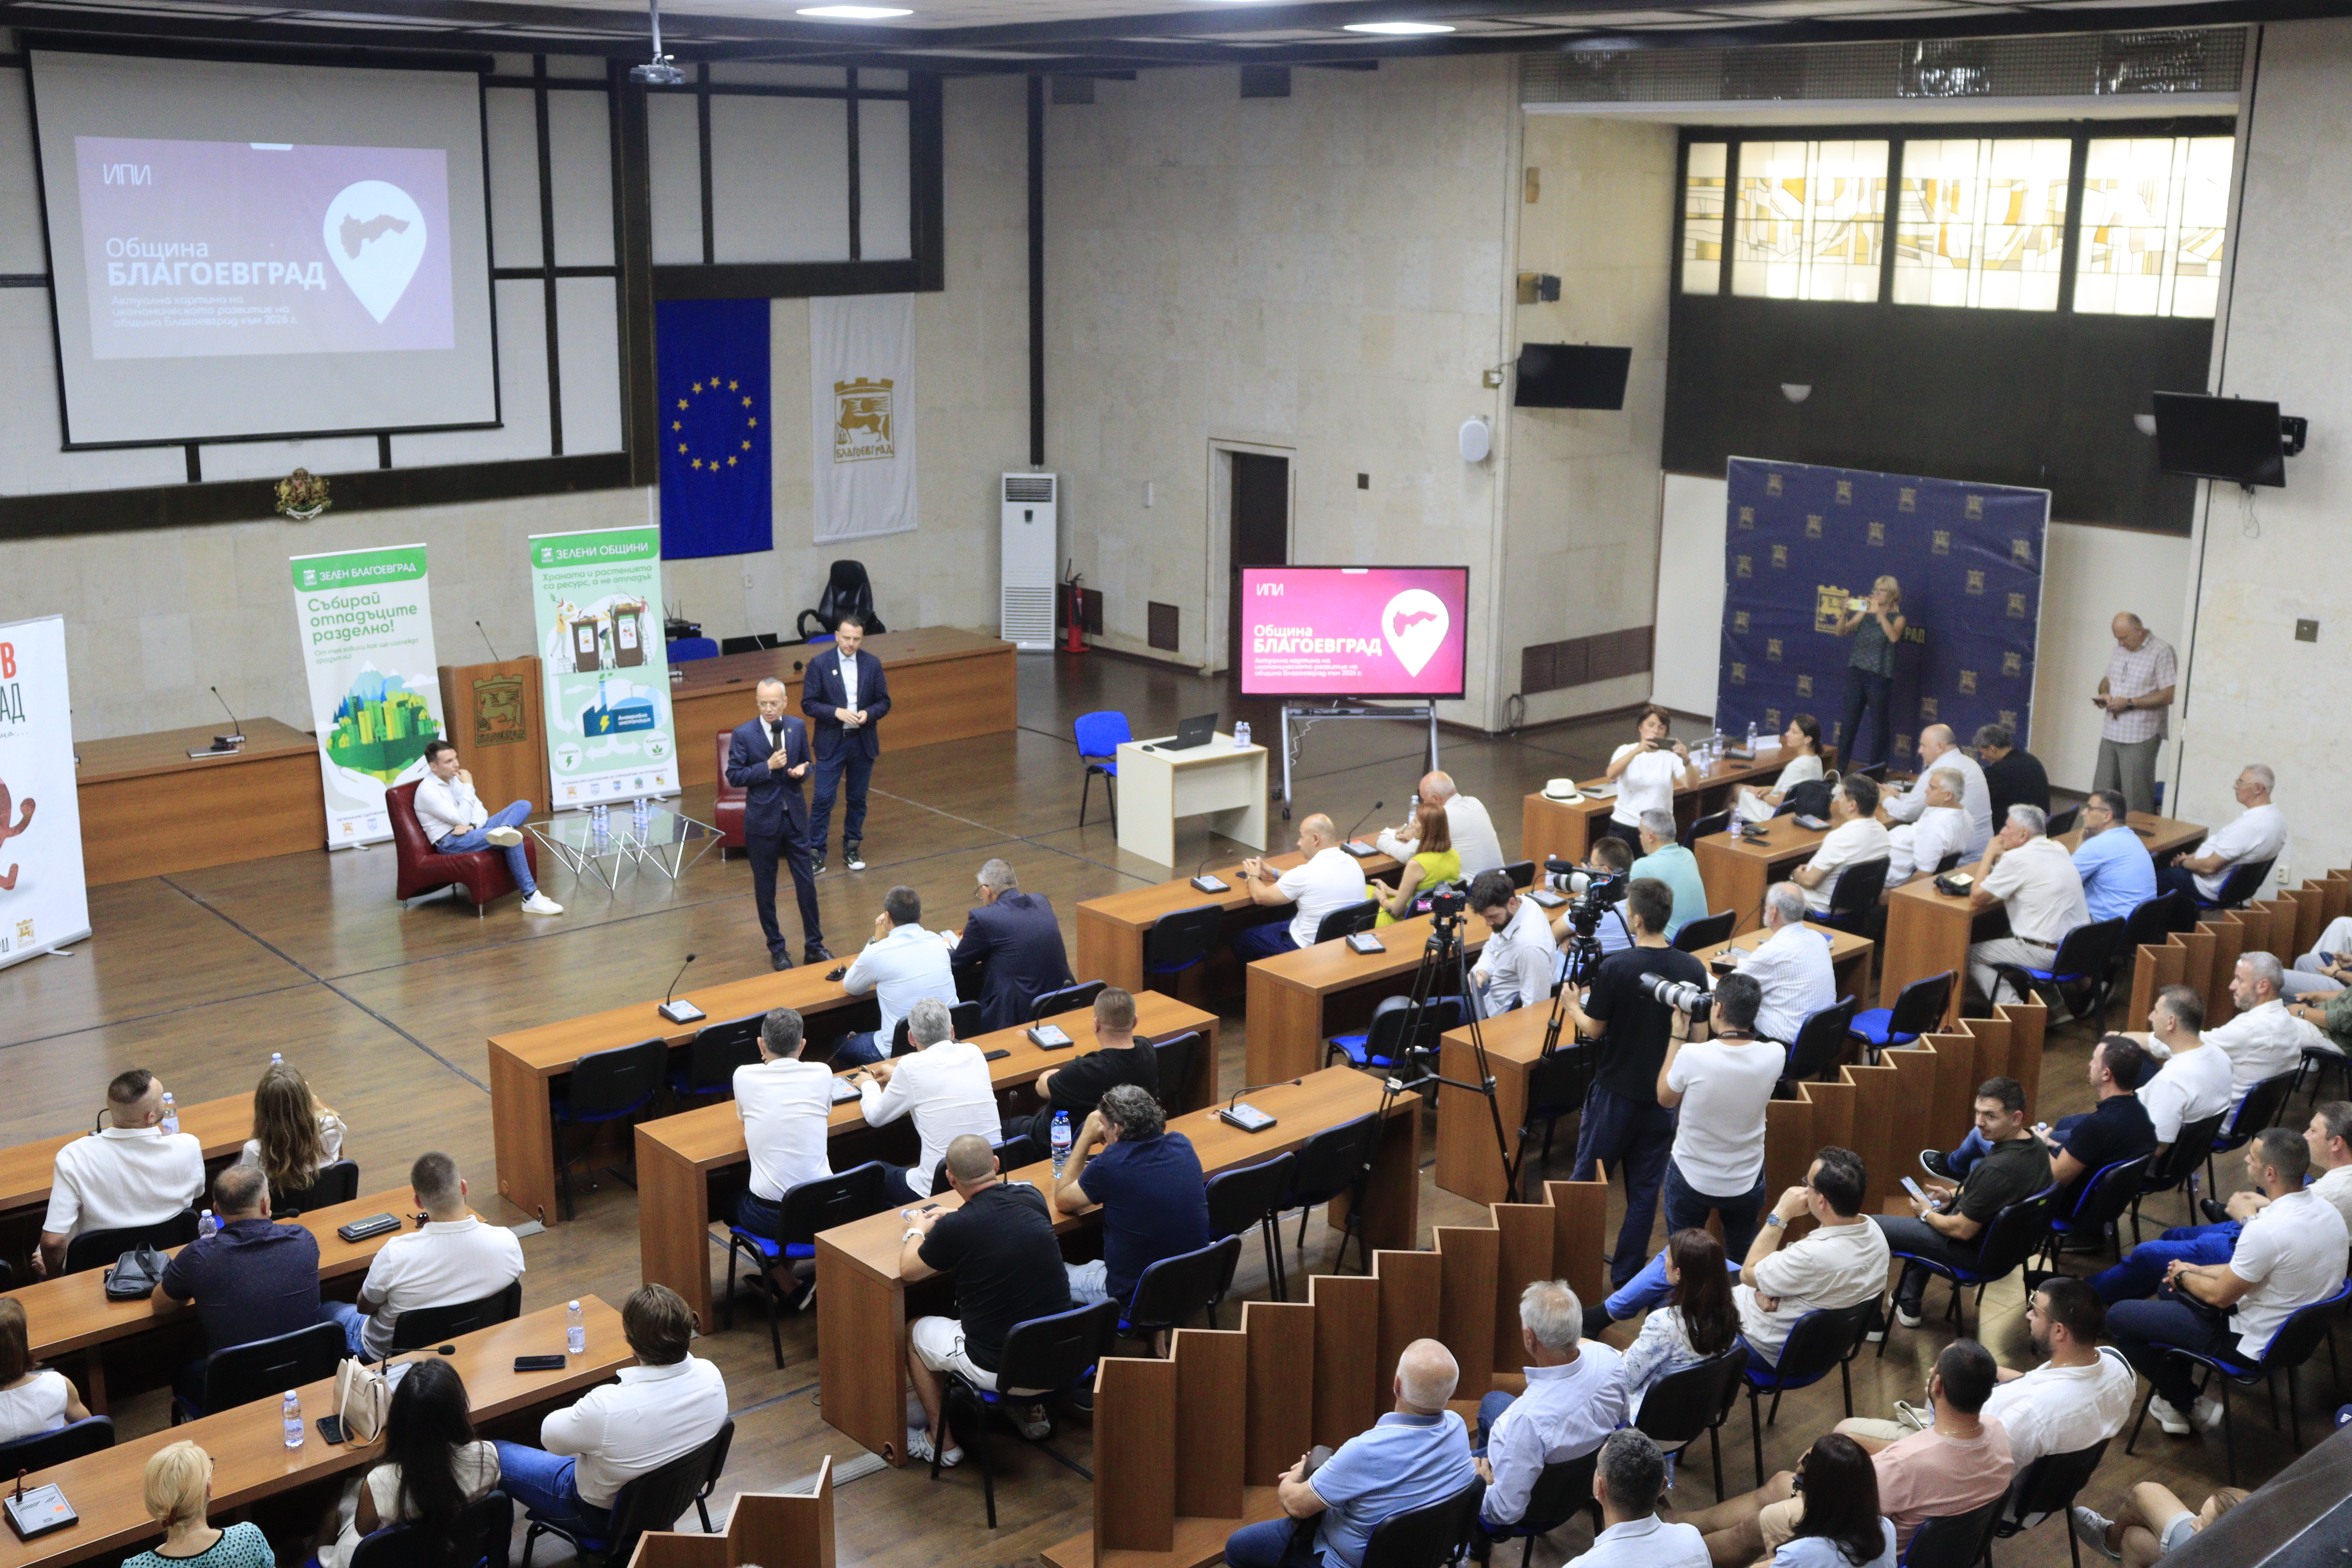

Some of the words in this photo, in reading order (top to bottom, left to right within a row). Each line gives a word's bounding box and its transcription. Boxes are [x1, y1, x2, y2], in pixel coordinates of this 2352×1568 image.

[103, 164, 151, 185] ИПИ
[105, 237, 208, 260] Община
[107, 261, 326, 290] БЛАГОЕВГРАД
[112, 296, 171, 306] Актуална
[174, 297, 226, 305] картина
[556, 547, 597, 560] ЗЕЛЕНИ
[599, 543, 649, 555] ОБЩИНИ
[319, 569, 349, 581] ЗЕЛЕН
[351, 563, 417, 577] БЛАГОЕВГРАД
[543, 570, 585, 582] Храната
[595, 566, 652, 578] растенията
[557, 580, 590, 590] ресурс,
[613, 573, 652, 583] отпадък
[1256, 583, 1283, 595] ИПИ
[308, 592, 380, 612] Събирай
[310, 605, 417, 627] отпадъците
[312, 619, 394, 645] разделно!
[1254, 625, 1312, 638] Община
[1254, 638, 1382, 656] БЛАГОЕВГРАД
[0, 642, 16, 679] В
[0, 682, 25, 724] АД
